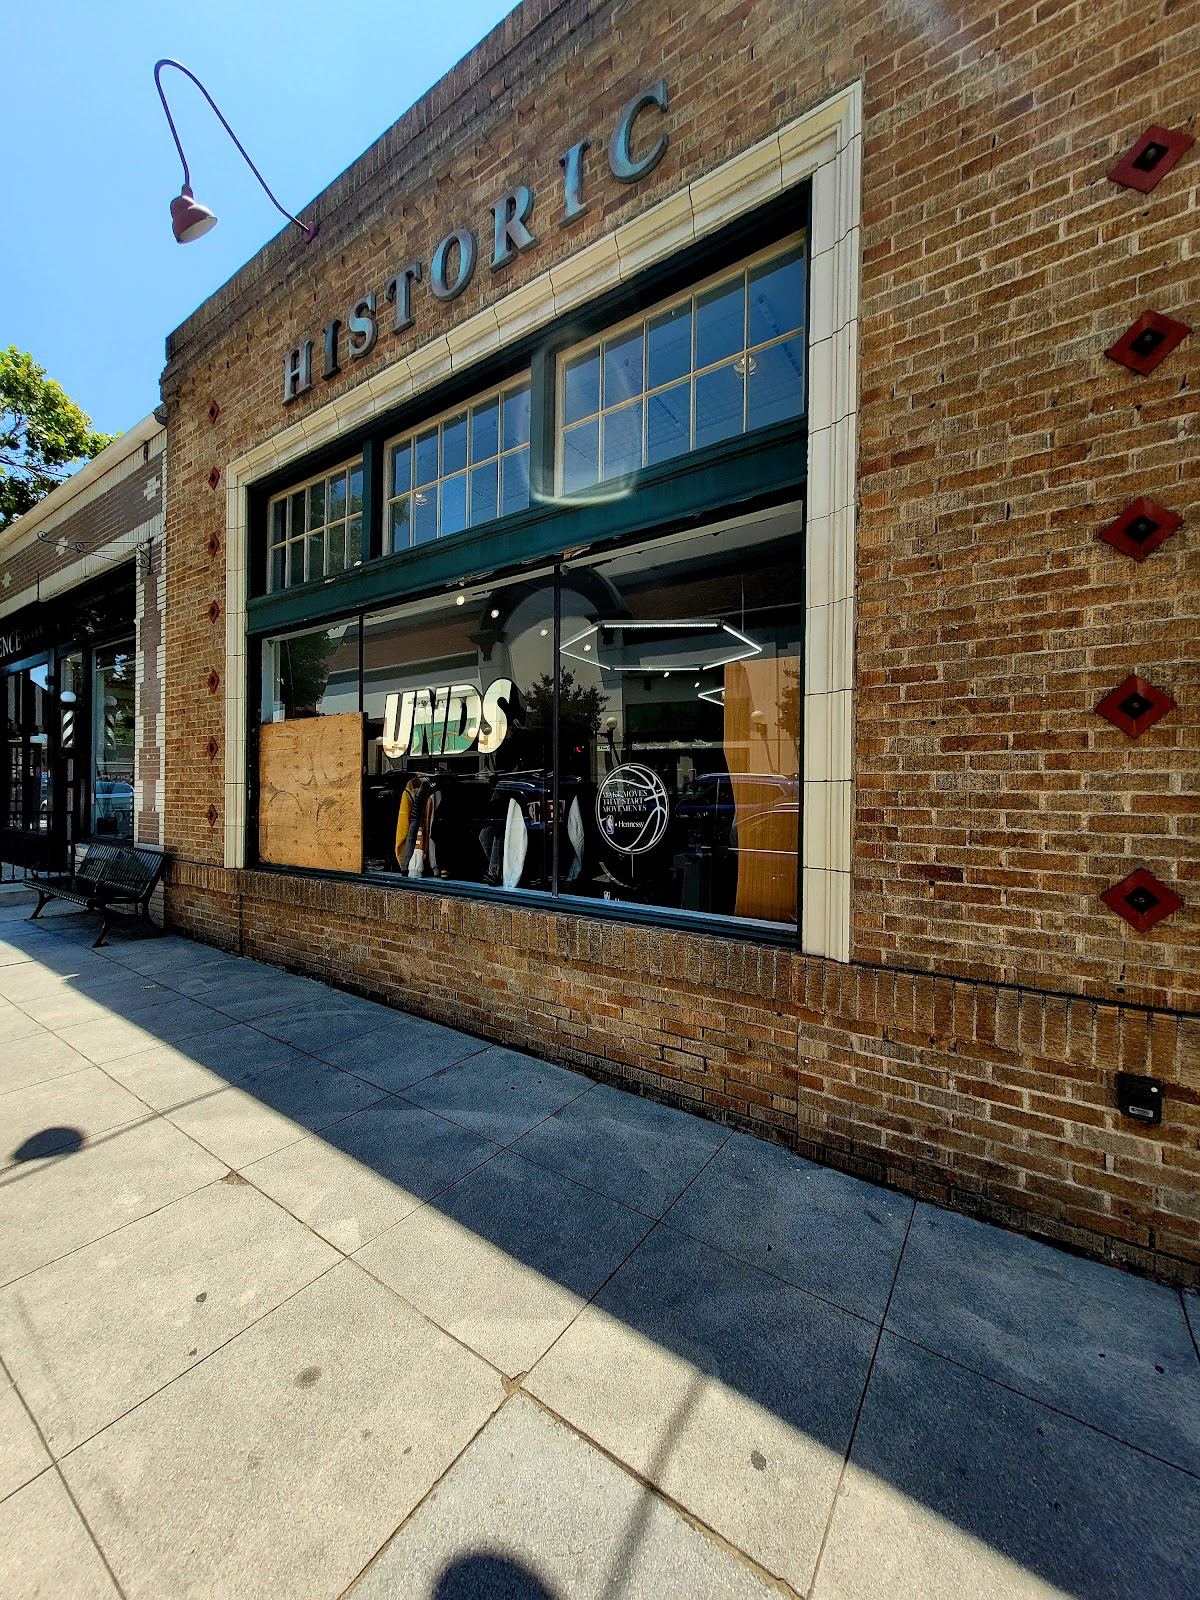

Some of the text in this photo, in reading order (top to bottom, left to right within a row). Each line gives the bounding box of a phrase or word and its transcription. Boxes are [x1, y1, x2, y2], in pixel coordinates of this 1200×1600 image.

[282, 80, 669, 406] HISTORIC
[602, 804, 647, 812] MOVEMENTS
[618, 820, 644, 828] Hennessy
